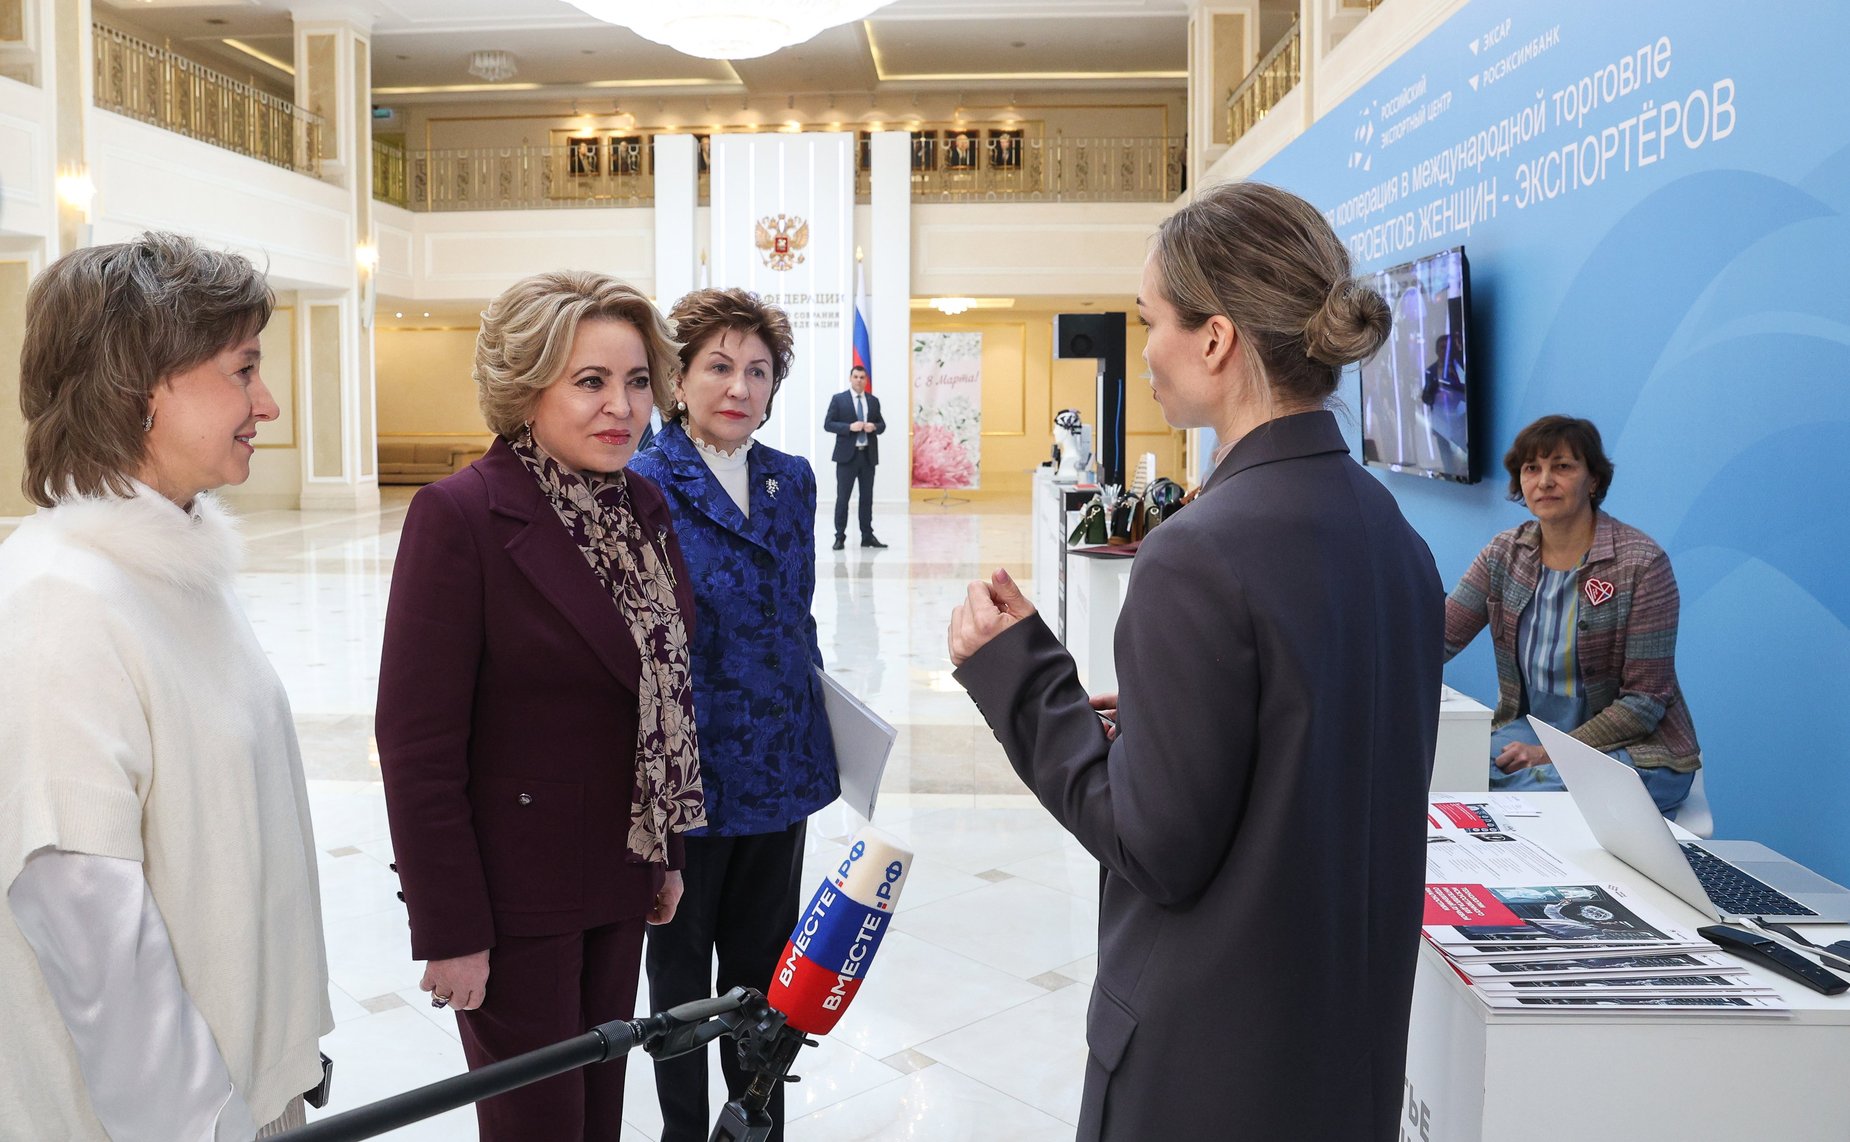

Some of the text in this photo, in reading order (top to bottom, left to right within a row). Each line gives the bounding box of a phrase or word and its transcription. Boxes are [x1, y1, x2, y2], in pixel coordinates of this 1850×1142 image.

[1483, 17, 1512, 51] ЭКСАР
[1483, 24, 1560, 87] РОСЭКСИМБАНК
[1381, 74, 1427, 121] РОССИЙСКИЙ
[1381, 90, 1453, 149] ЭКСПОРТНЫЙ ЦЕНТР
[1337, 35, 1672, 228] кооперация в международной торговле
[1350, 211, 1415, 262] ПРОЕКТОВ
[1417, 176, 1497, 243] ЖЕНЩИН
[1515, 78, 1736, 209] ЭКСПОРТЁРОВ
[926, 375, 933, 387] 8
